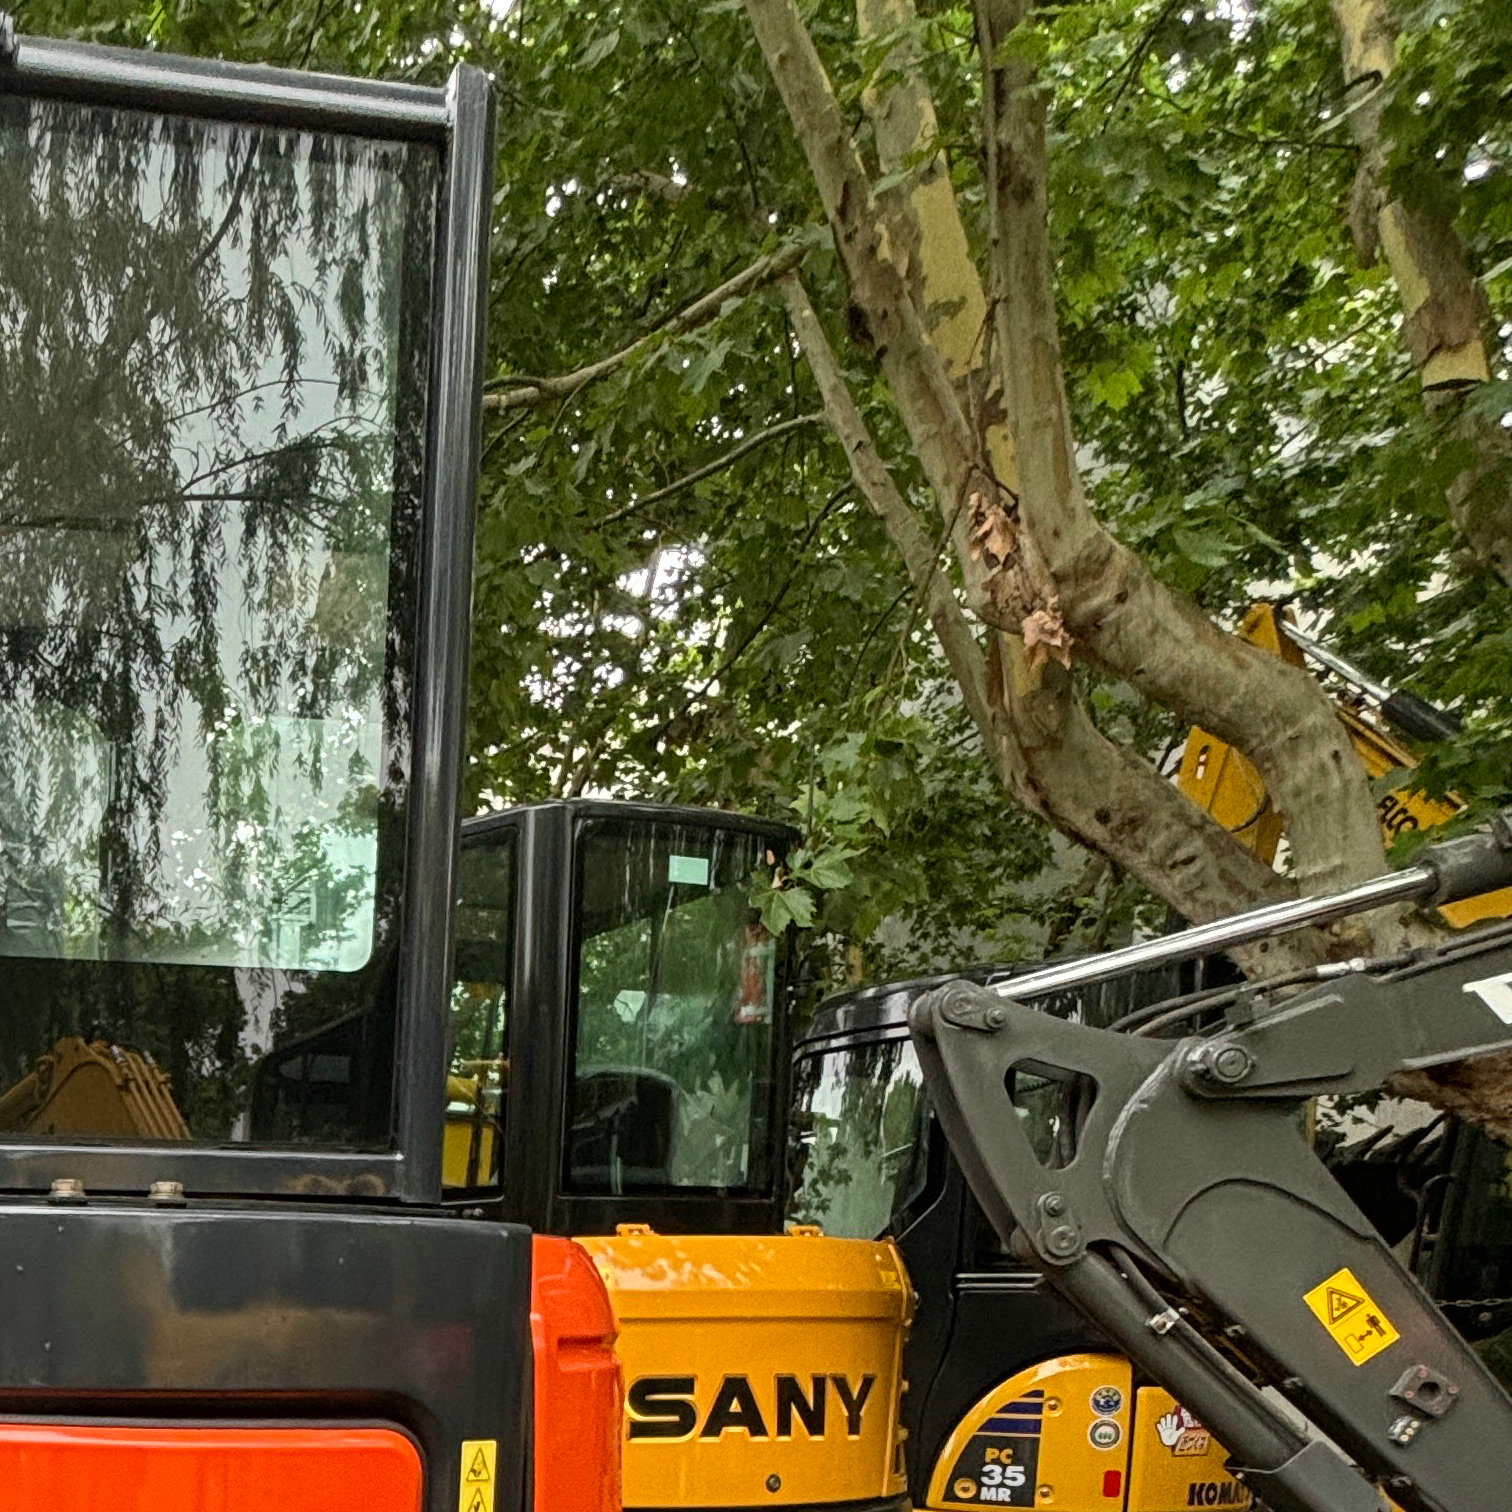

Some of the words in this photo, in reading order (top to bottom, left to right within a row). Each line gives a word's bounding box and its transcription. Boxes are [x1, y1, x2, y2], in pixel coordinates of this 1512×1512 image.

[626, 1373, 878, 1443] SANY
[985, 1447, 1014, 1465] PC
[980, 1464, 1026, 1487] 35
[979, 1486, 1012, 1502] MR
